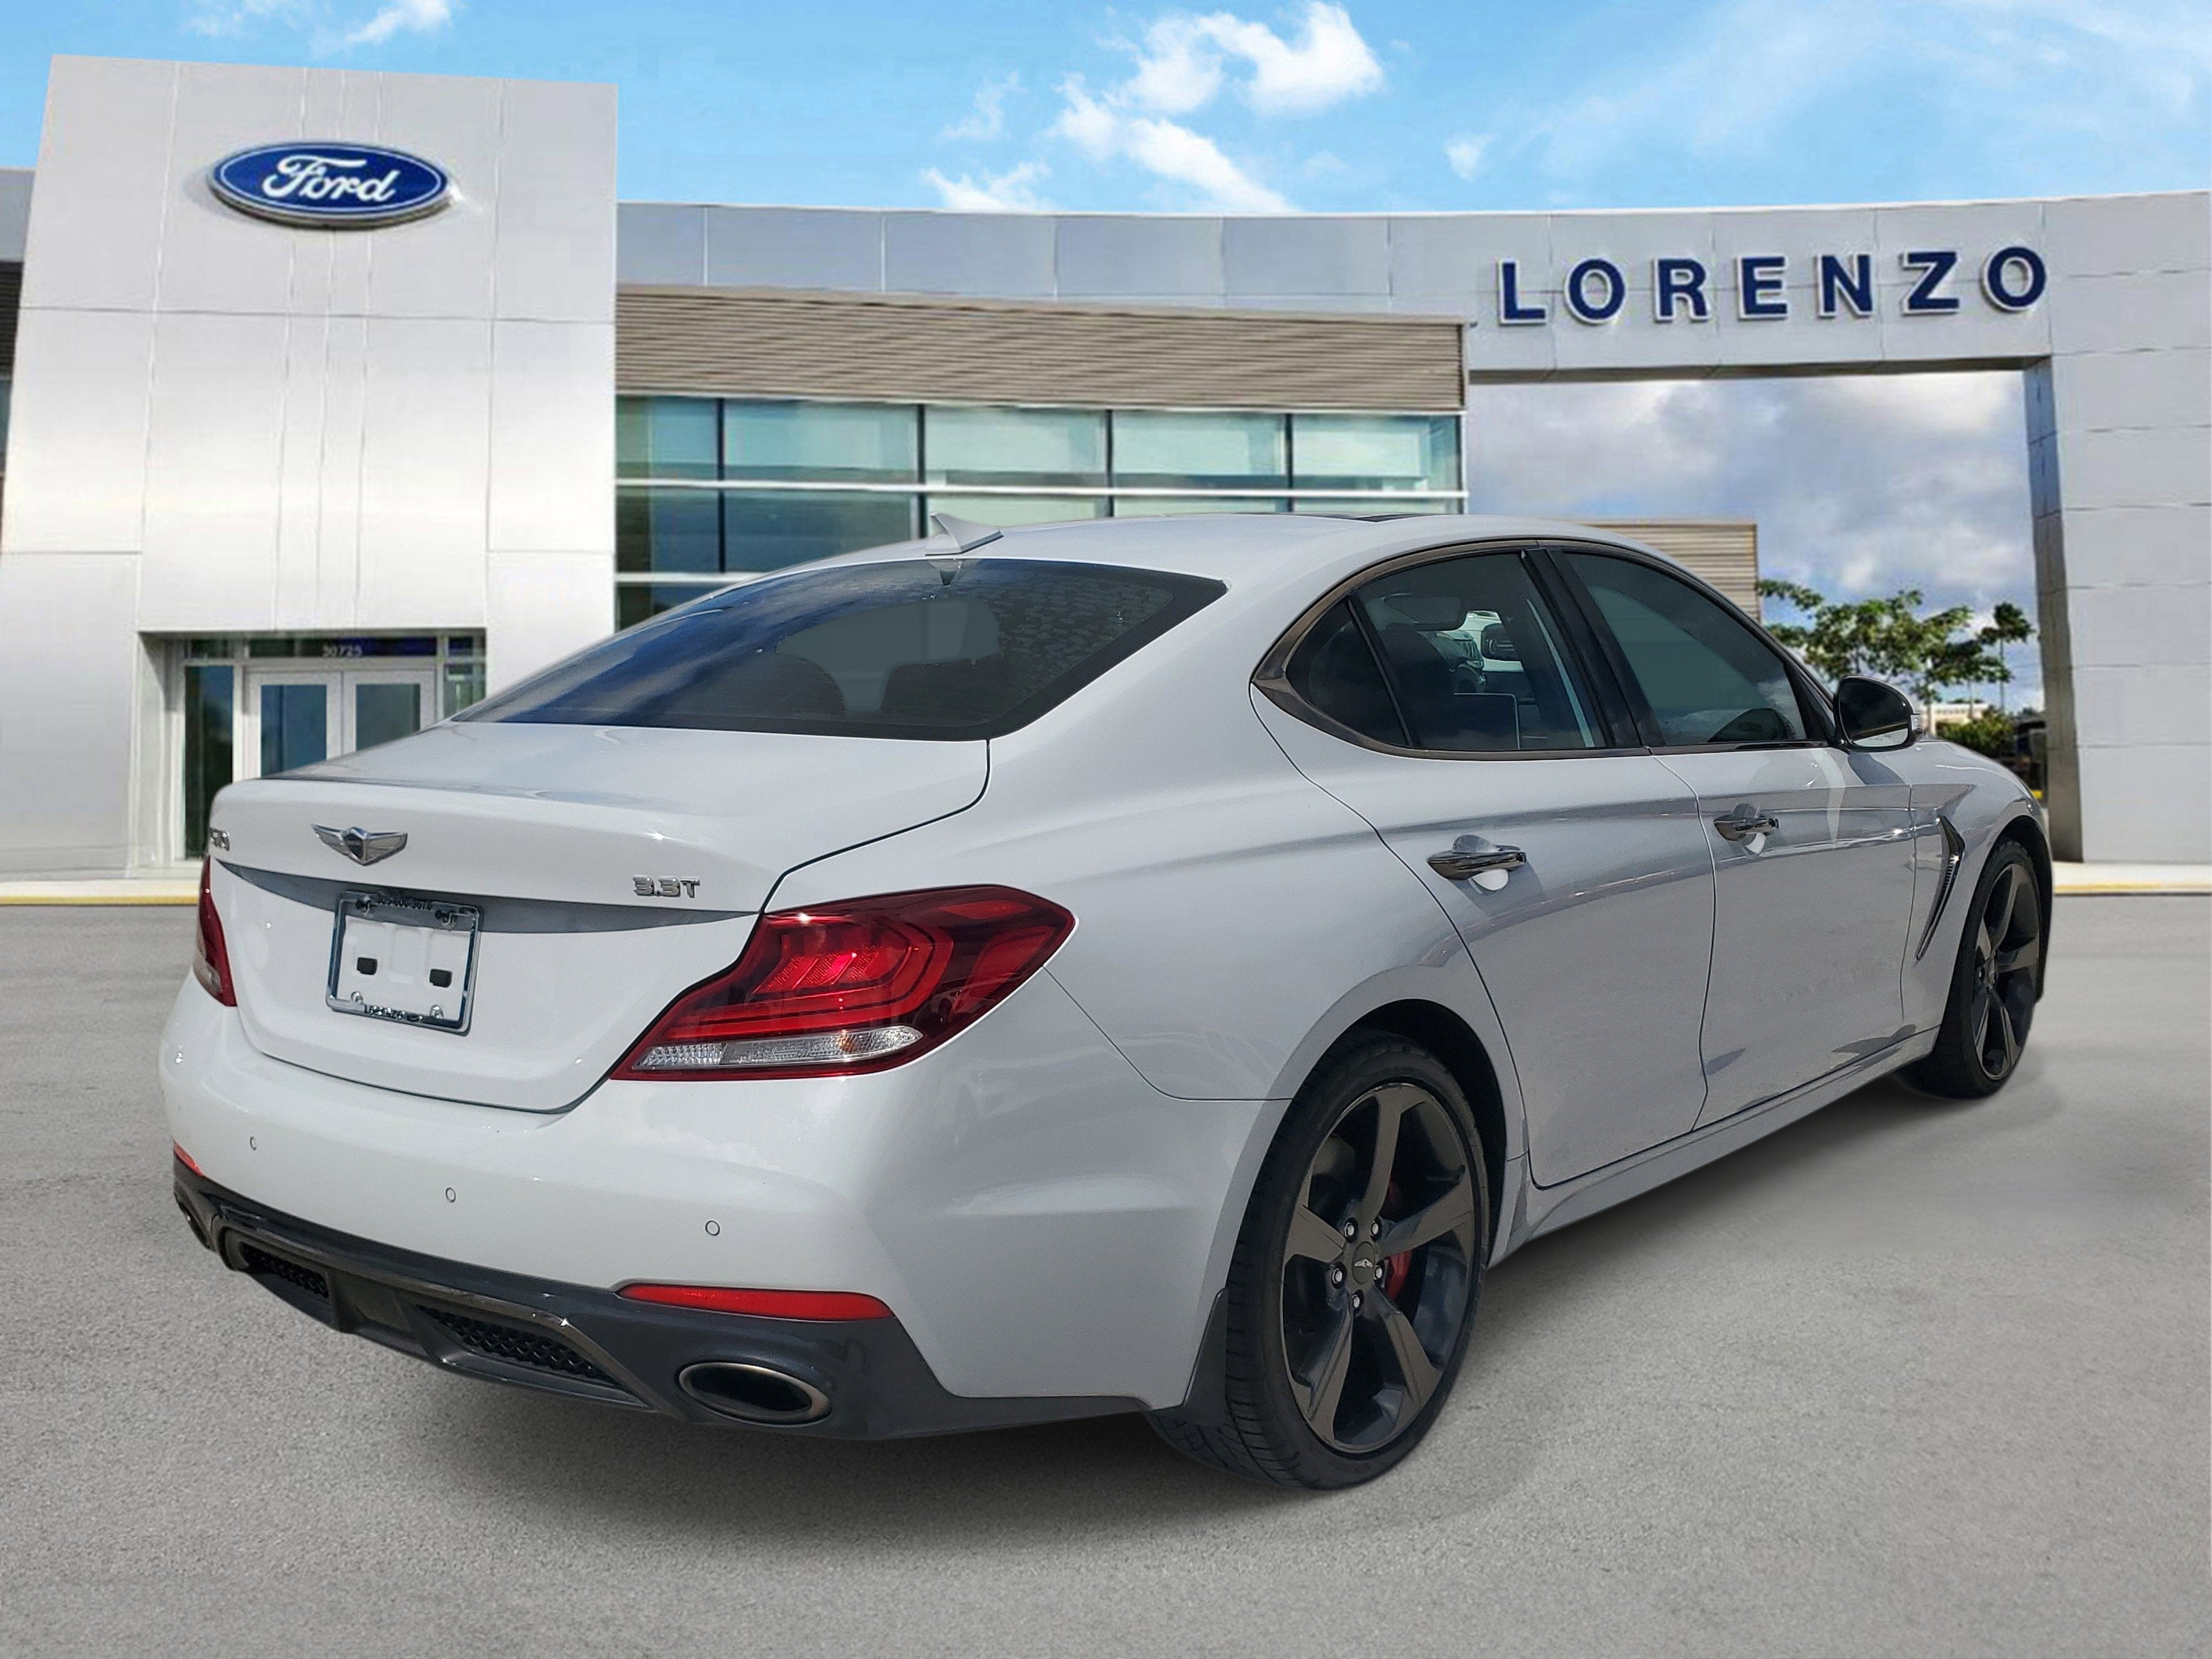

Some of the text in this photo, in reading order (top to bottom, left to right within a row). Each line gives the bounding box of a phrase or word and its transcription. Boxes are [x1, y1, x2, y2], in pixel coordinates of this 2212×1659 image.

[262, 154, 401, 202] Ford
[1497, 246, 2048, 325] LORENZO
[632, 875, 701, 899] 3.3T
